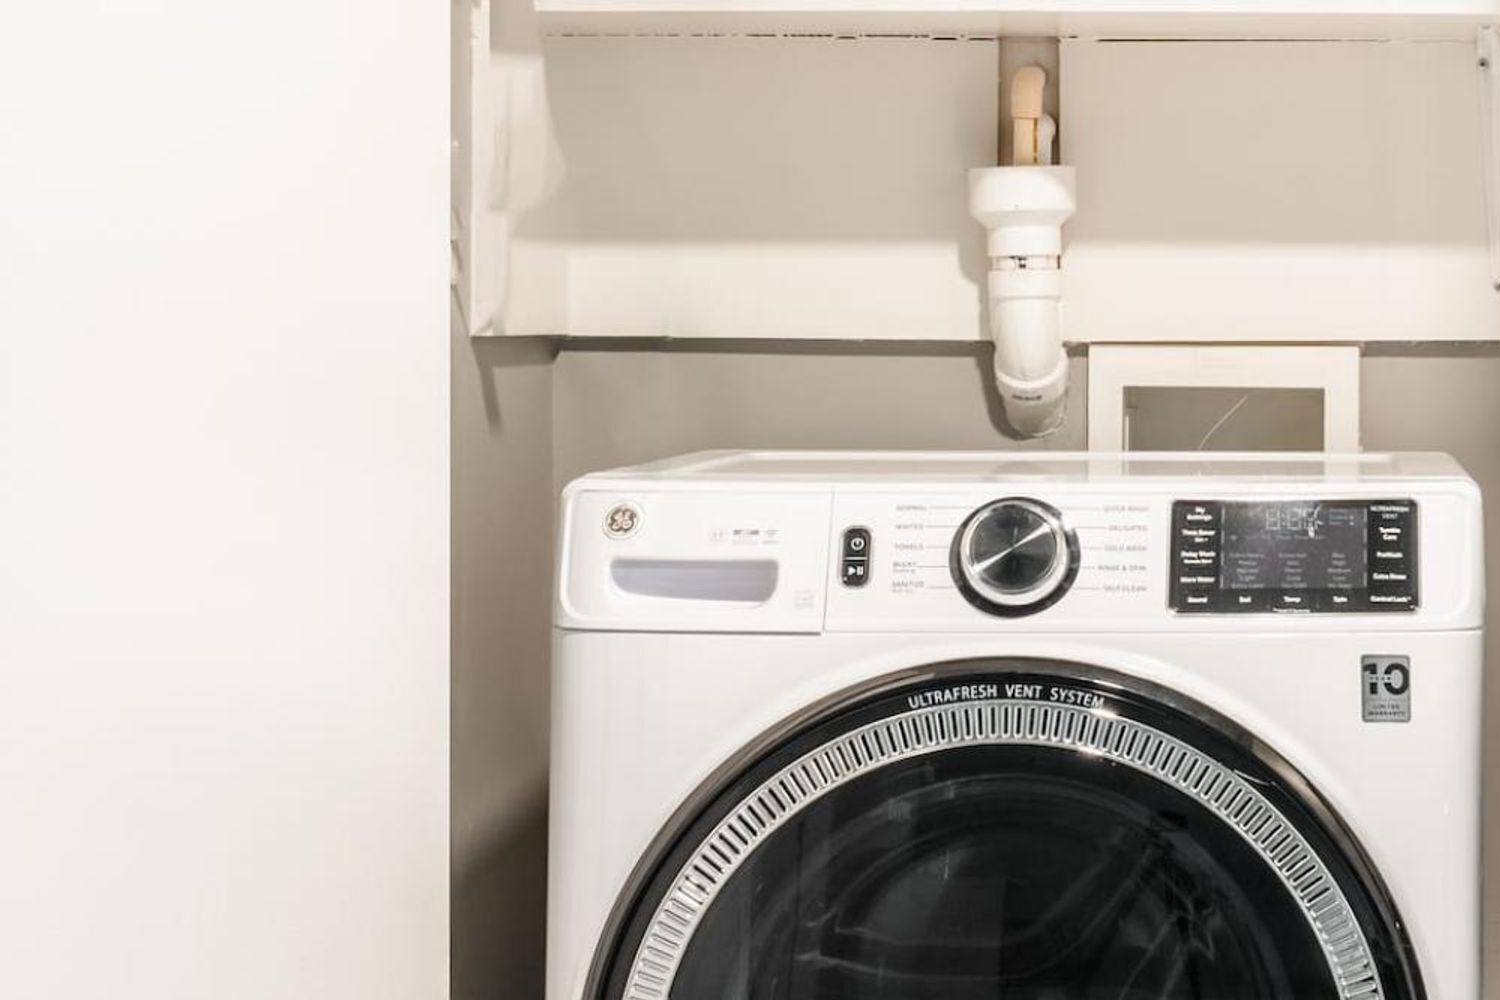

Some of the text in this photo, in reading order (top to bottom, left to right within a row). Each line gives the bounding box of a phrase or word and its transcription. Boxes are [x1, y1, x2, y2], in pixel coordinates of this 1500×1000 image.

[908, 684, 1105, 709] ULTRAFRESH VENT SYSTEM
